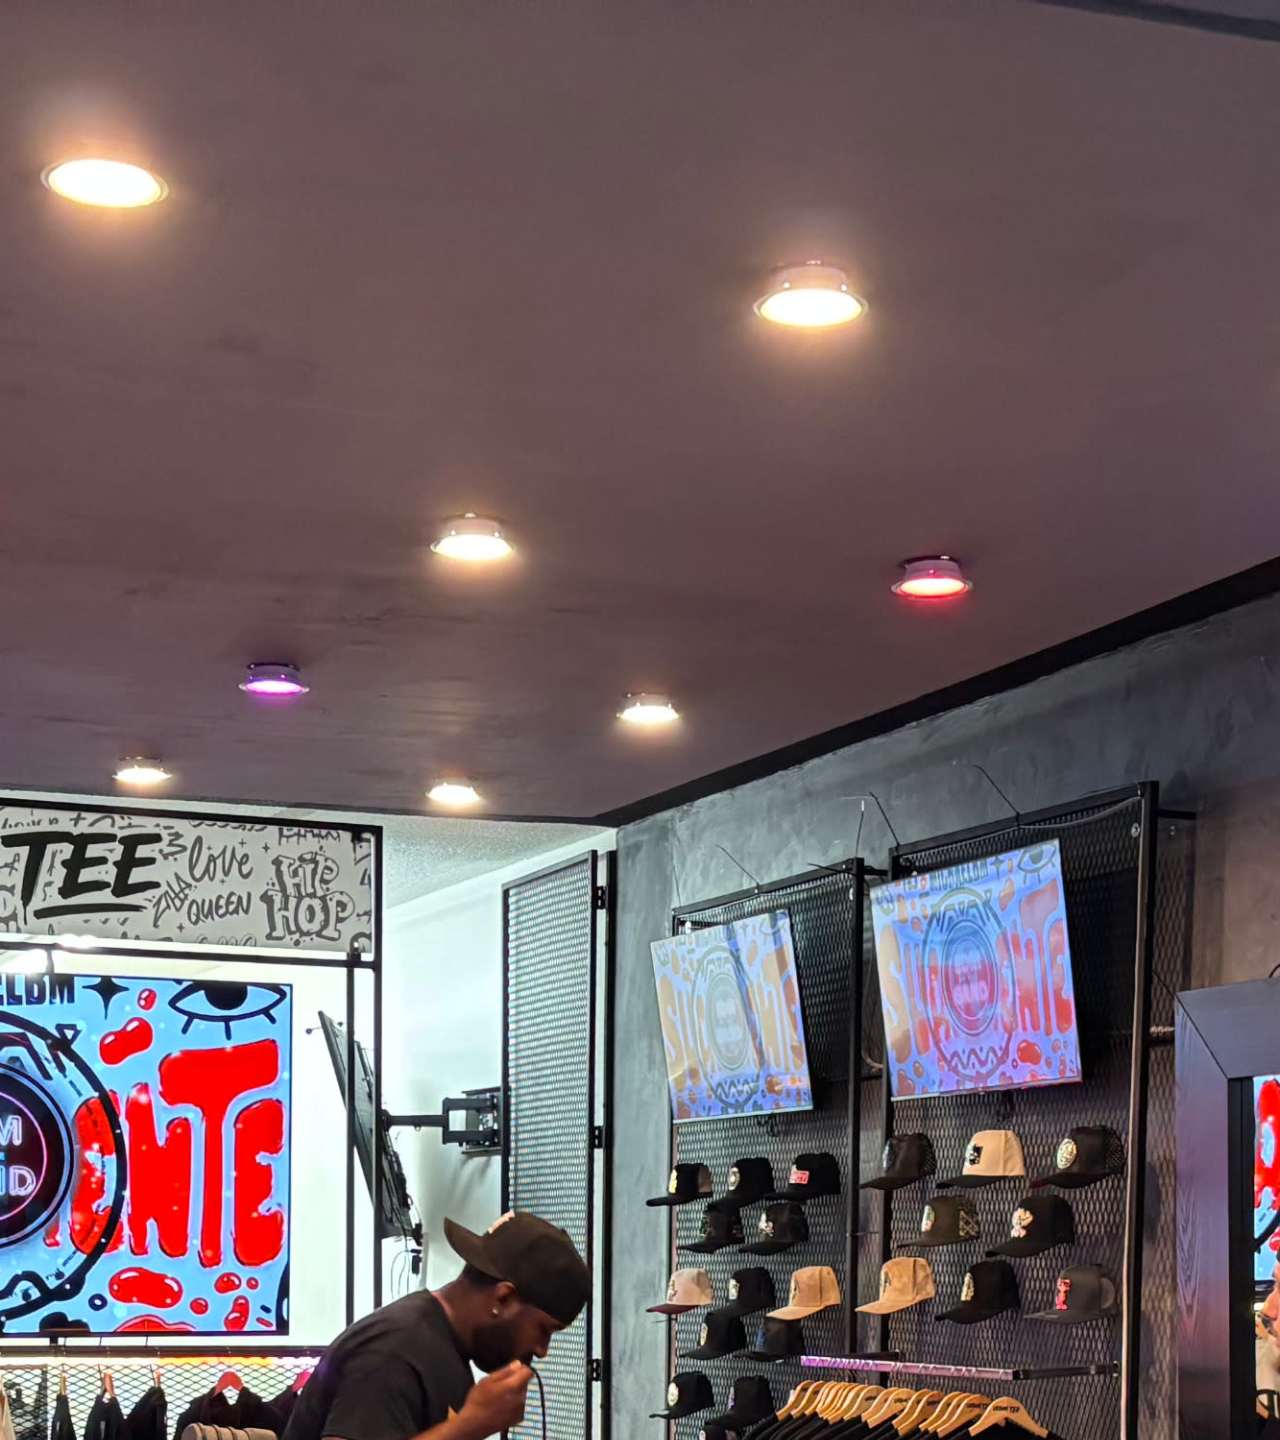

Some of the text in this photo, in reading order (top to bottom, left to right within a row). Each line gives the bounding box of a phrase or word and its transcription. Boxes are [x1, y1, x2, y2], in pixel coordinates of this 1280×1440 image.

[1, 830, 163, 905] TEE
[188, 836, 254, 882] love
[187, 892, 252, 926] QUEEN
[260, 889, 355, 941] HOP
